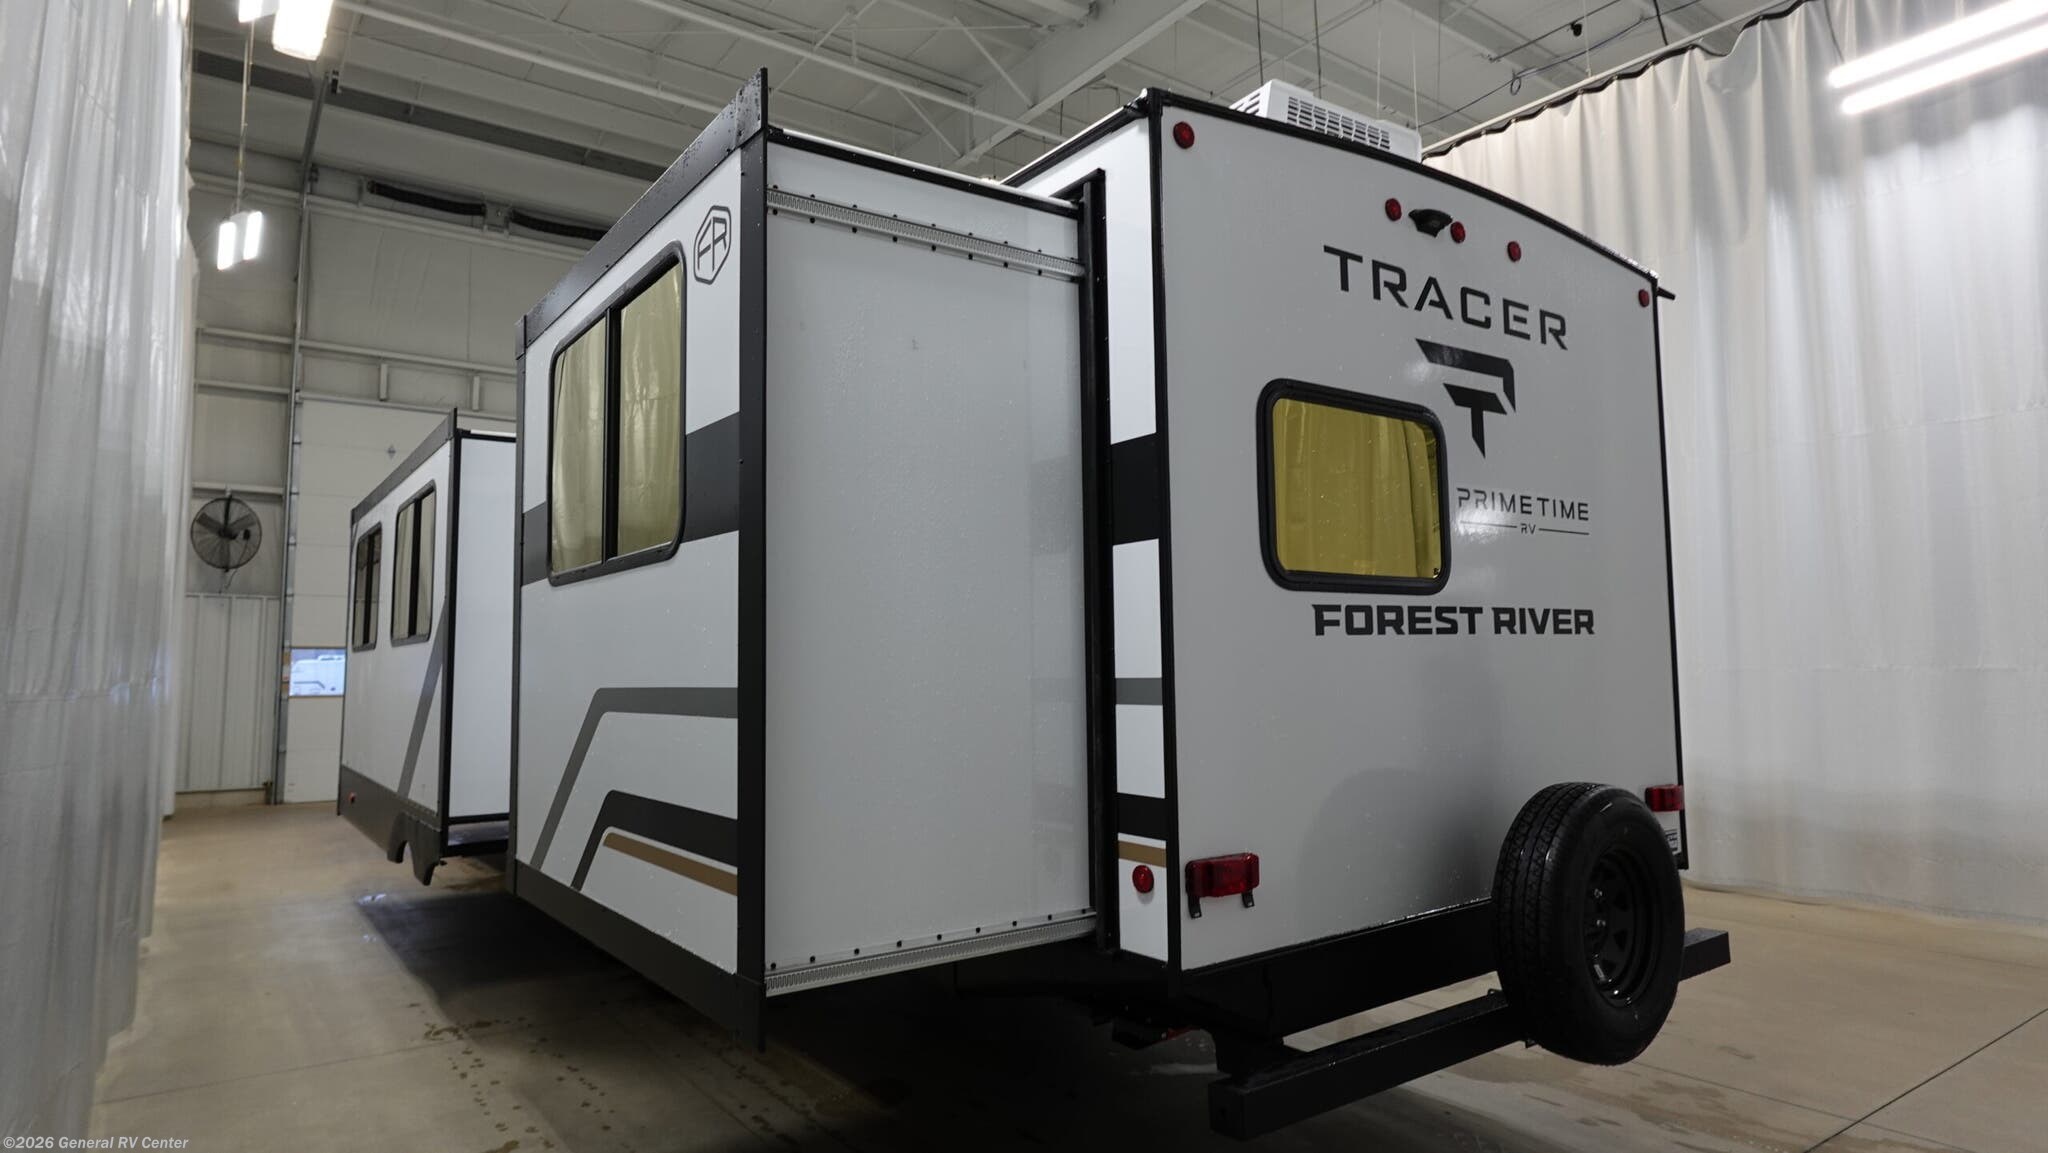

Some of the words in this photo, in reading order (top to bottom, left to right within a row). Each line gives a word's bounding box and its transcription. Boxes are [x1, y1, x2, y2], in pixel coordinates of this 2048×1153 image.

[1323, 245, 1568, 350] TRACER
[1520, 523, 1536, 535] RV
[1312, 605, 1483, 636] FOREST
[1491, 607, 1594, 635] RIVER
